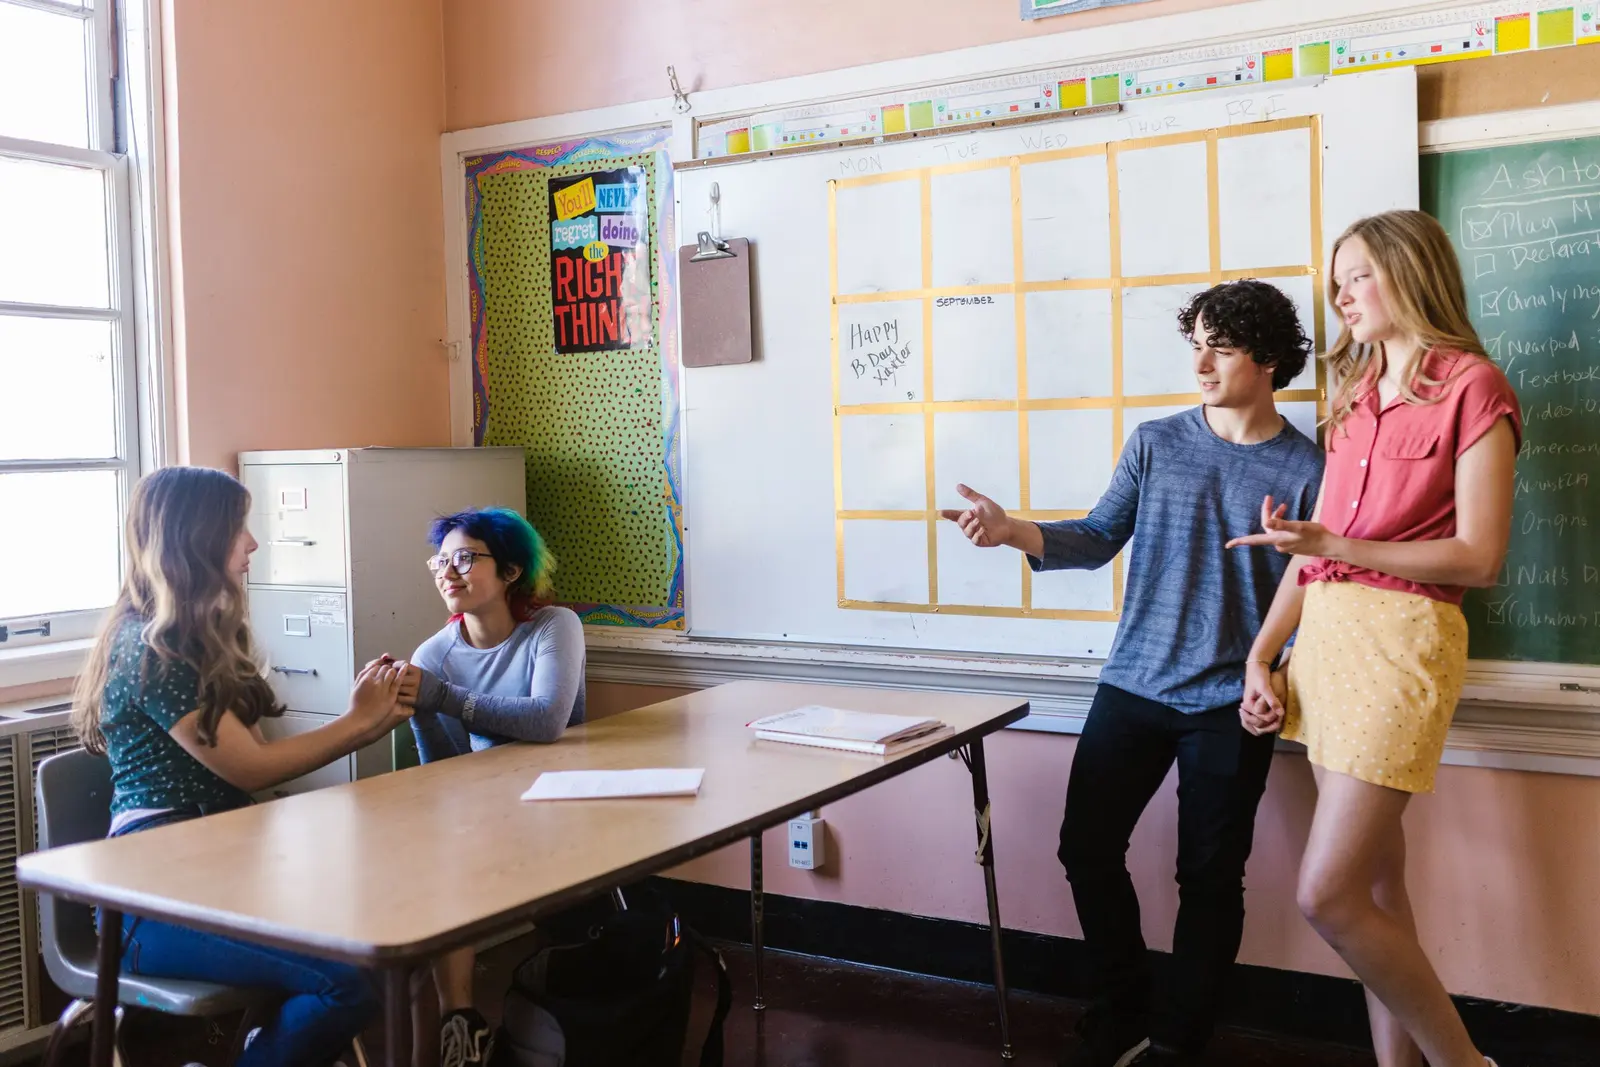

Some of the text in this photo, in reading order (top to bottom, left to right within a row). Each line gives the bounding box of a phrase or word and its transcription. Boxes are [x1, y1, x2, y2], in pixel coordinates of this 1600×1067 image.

[1117, 115, 1180, 137] THUR
[535, 145, 563, 155] RESPECT
[933, 141, 980, 160] TUE
[1020, 129, 1068, 150] WED
[495, 161, 521, 171] CARING
[840, 153, 882, 175] MON
[558, 182, 593, 216] You'll
[555, 219, 640, 246] regret doing
[1498, 210, 1558, 243] Play
[589, 244, 605, 259] the
[556, 252, 636, 302] RIGH
[936, 296, 994, 307] SEPTEMBER
[851, 319, 899, 350] Happy
